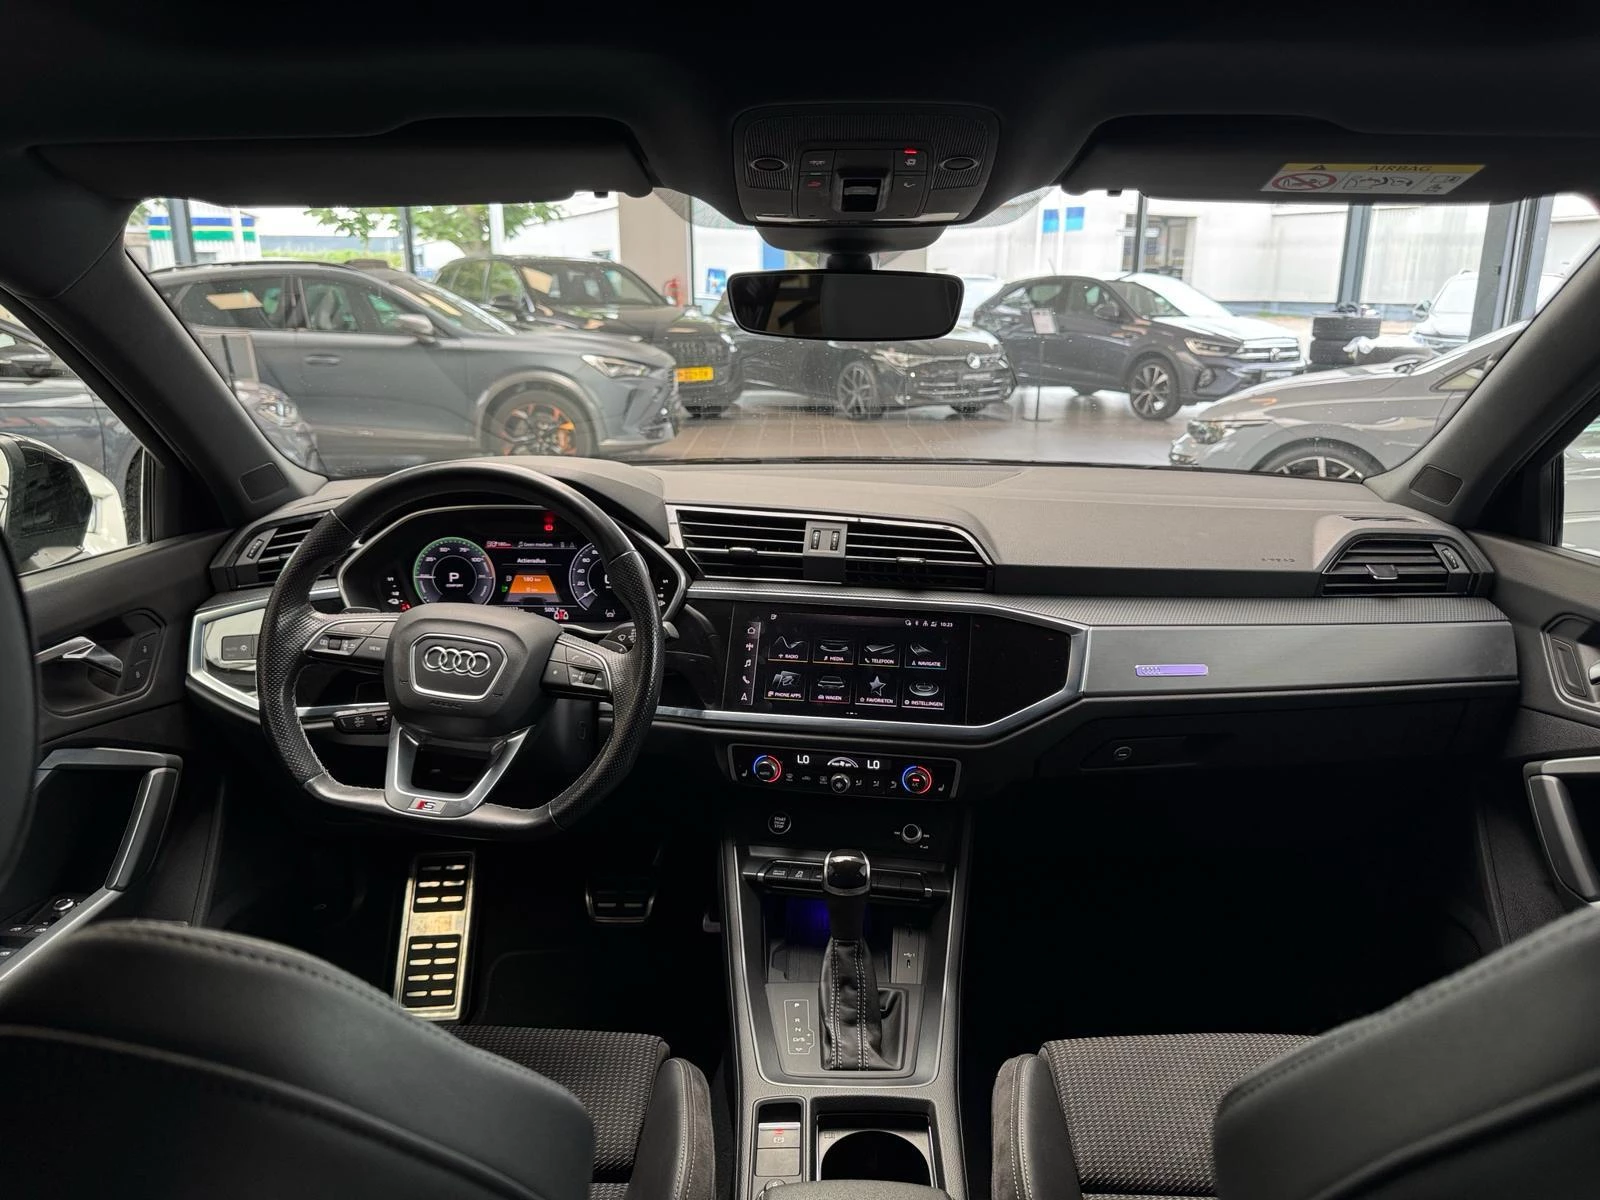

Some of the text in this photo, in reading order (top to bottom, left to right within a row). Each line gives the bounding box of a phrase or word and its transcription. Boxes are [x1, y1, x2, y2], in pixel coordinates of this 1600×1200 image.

[448, 572, 460, 583] P
[797, 754, 810, 764] LO
[867, 760, 880, 769] LO
